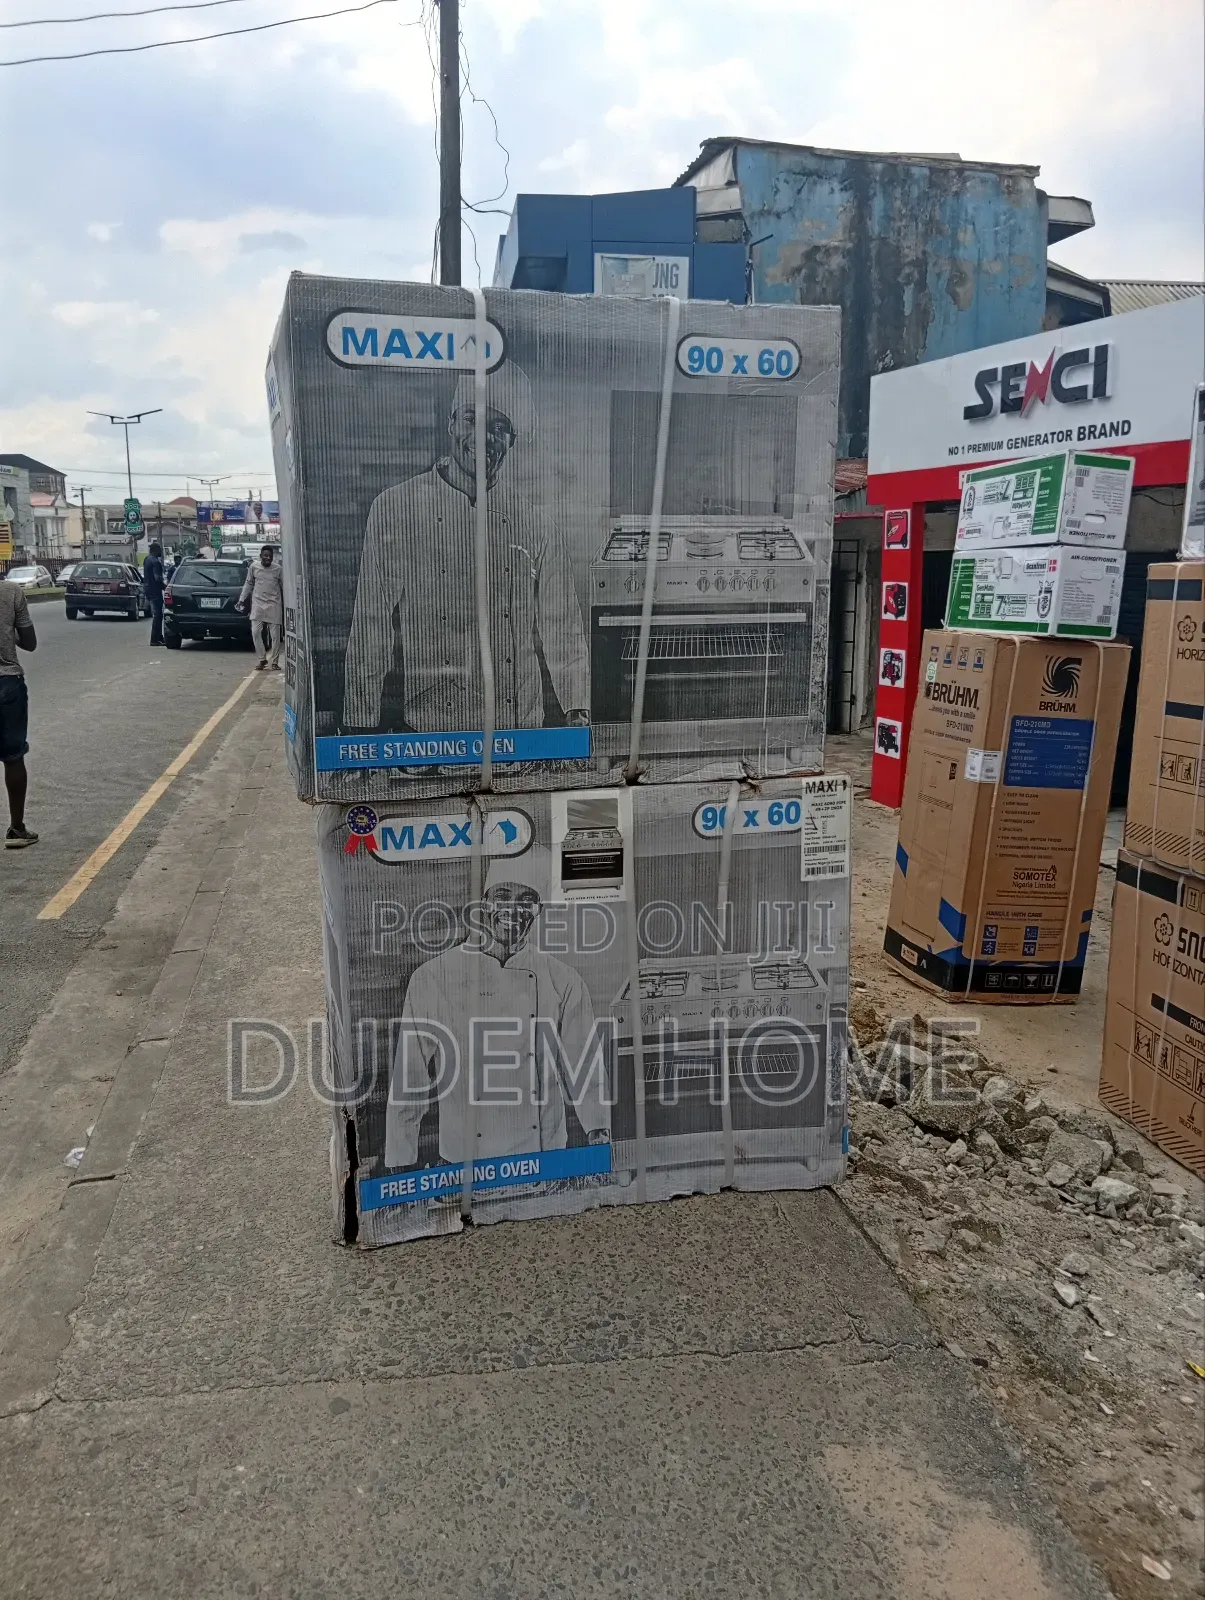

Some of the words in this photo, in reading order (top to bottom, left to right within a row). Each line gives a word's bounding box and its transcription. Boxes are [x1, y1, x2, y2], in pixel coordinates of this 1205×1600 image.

[342, 326, 455, 361] MAXI
[687, 345, 724, 374] 90
[731, 354, 749, 375] x
[757, 348, 793, 377] 60
[963, 343, 1109, 418] SENCI
[948, 446, 960, 456] NO
[961, 446, 966, 455] 1
[967, 440, 1004, 455] PREMIUM
[1006, 429, 1073, 451] GENERATOR
[1076, 419, 1132, 442] BRAND
[338, 741, 378, 762] FREE
[383, 738, 468, 760] STANDING
[471, 737, 516, 757] OEN
[805, 780, 838, 795] MAXI
[742, 809, 760, 828] x
[767, 800, 802, 827] 60
[380, 821, 480, 851] MAX
[1012, 871, 1056, 881] SOMOTEX
[1034, 881, 1056, 889] Limited
[380, 1177, 417, 1200] FREE
[500, 1158, 541, 1179] OVEN
